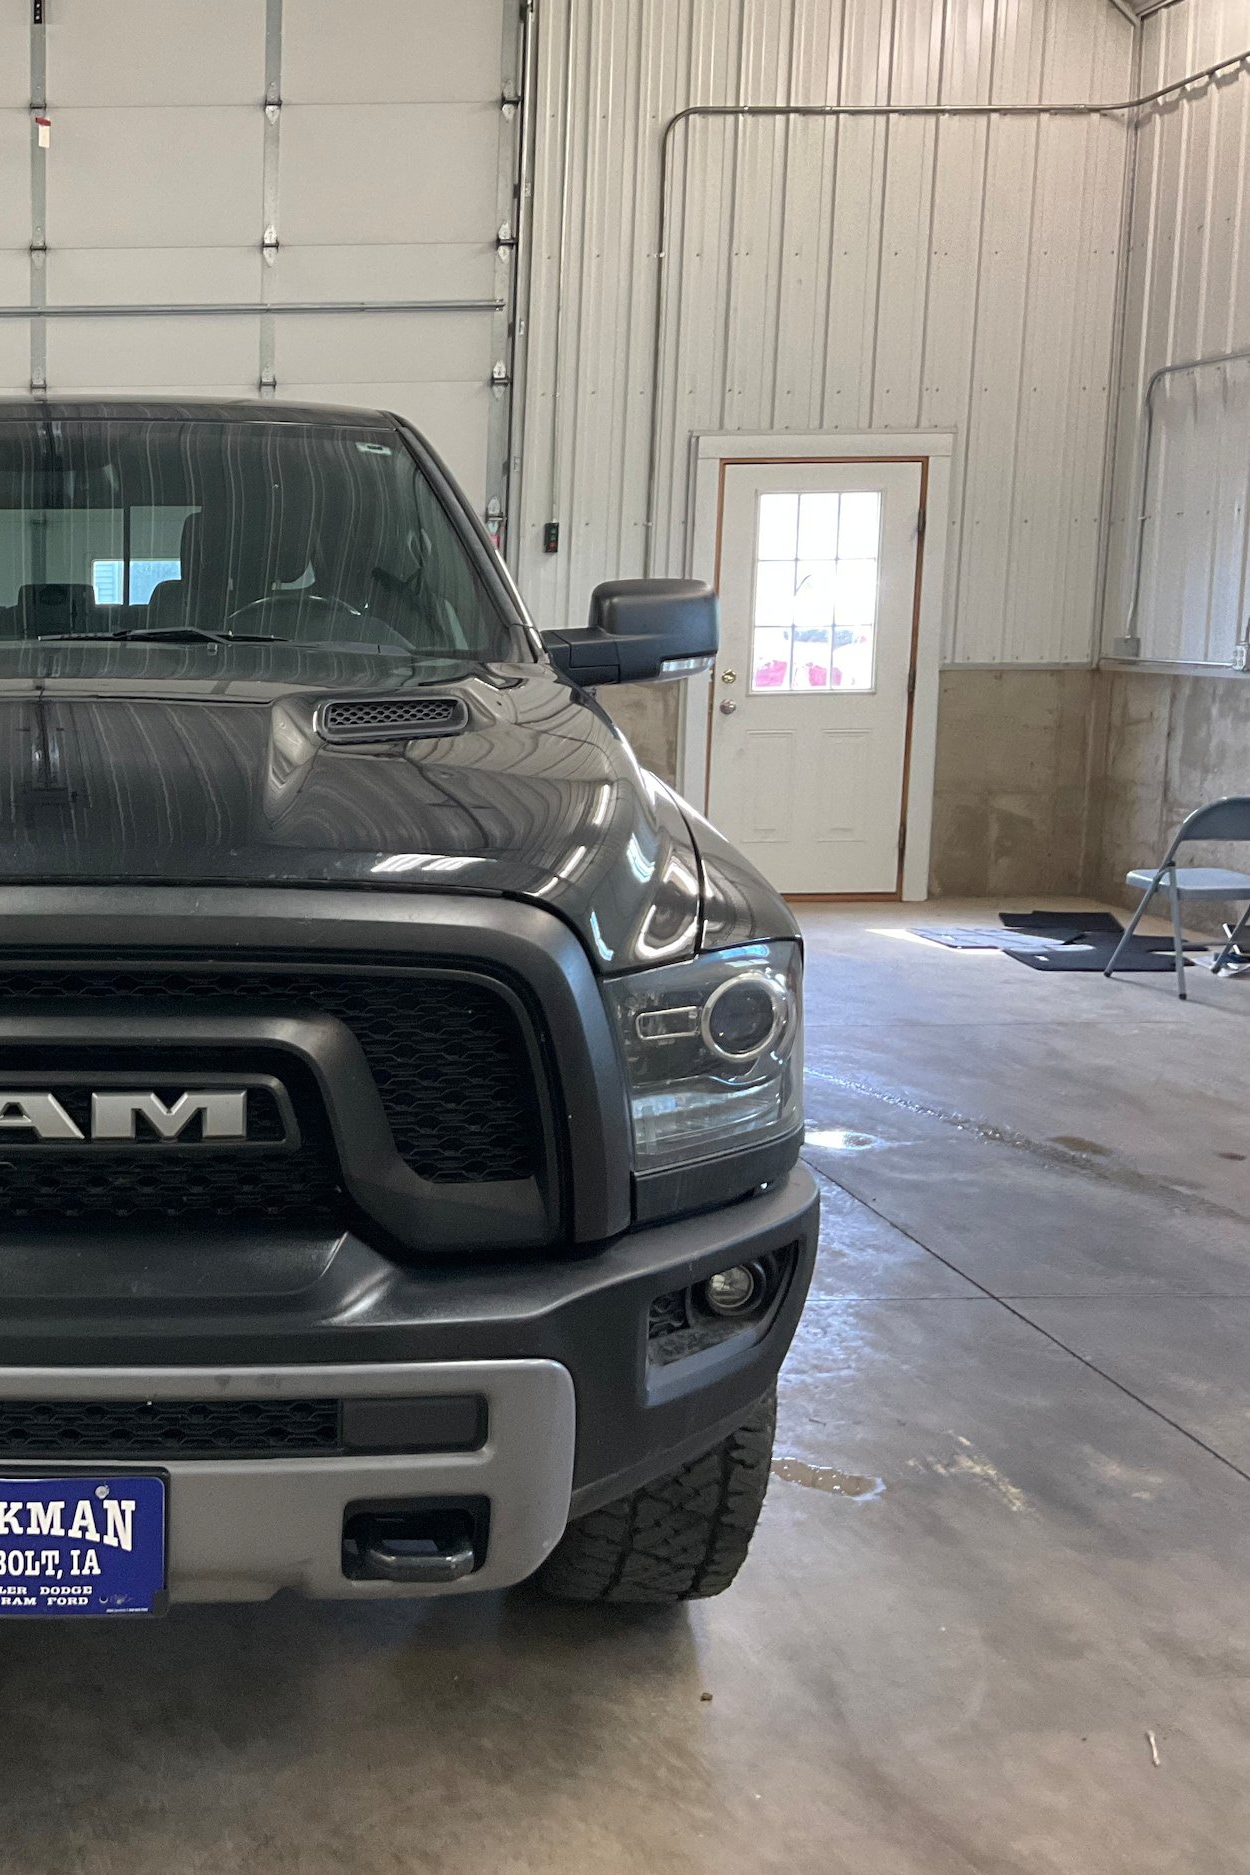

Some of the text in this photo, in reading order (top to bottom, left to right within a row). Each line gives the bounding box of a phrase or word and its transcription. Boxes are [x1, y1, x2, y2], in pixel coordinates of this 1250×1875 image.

[70, 1549, 101, 1575] IA
[39, 1585, 93, 1595] DODGE
[0, 1596, 37, 1606] RAM
[47, 1596, 89, 1606] FORD
